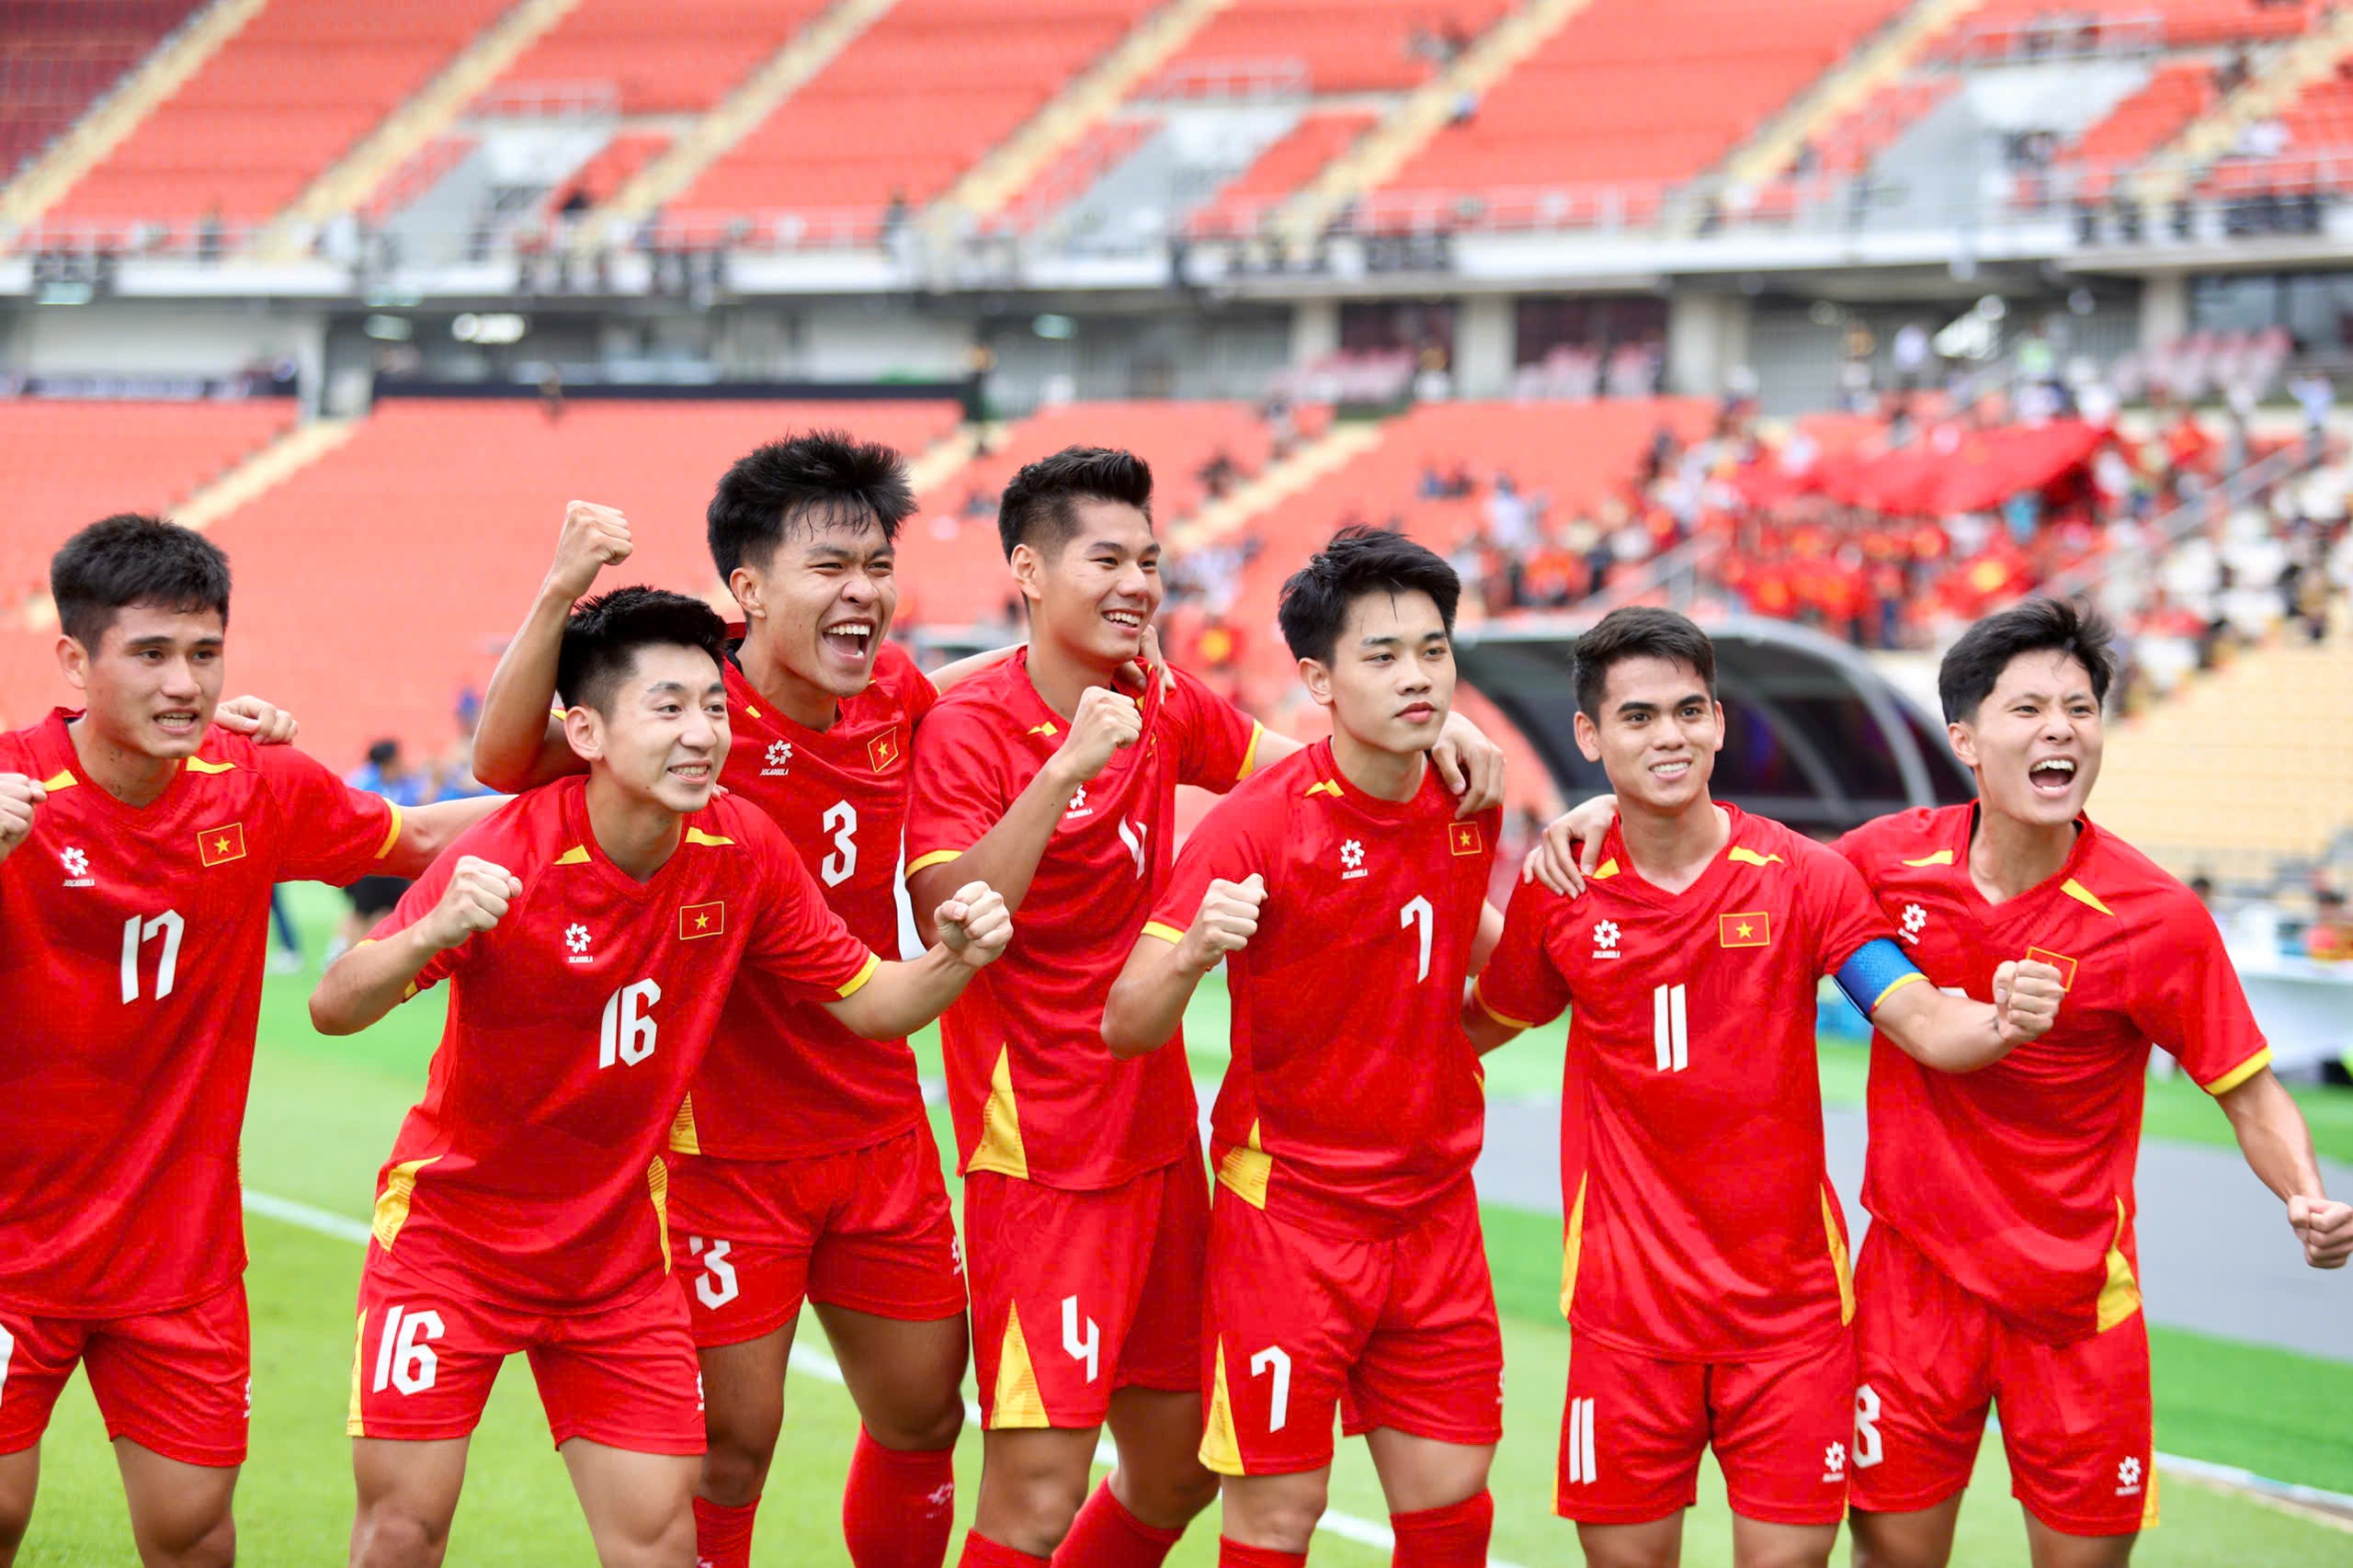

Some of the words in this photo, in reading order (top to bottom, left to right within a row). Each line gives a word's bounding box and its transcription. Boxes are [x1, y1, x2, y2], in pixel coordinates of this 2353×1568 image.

[821, 799, 858, 888] 3
[120, 909, 185, 1005] 17
[1400, 894, 1434, 983] 7
[598, 977, 662, 1070] 16
[1654, 983, 1688, 1073] 11
[690, 1236, 739, 1311] 3
[372, 1304, 446, 1396] 16
[1062, 1294, 1100, 1383] 4
[1250, 1345, 1291, 1433] 7
[1568, 1395, 1597, 1485] 11
